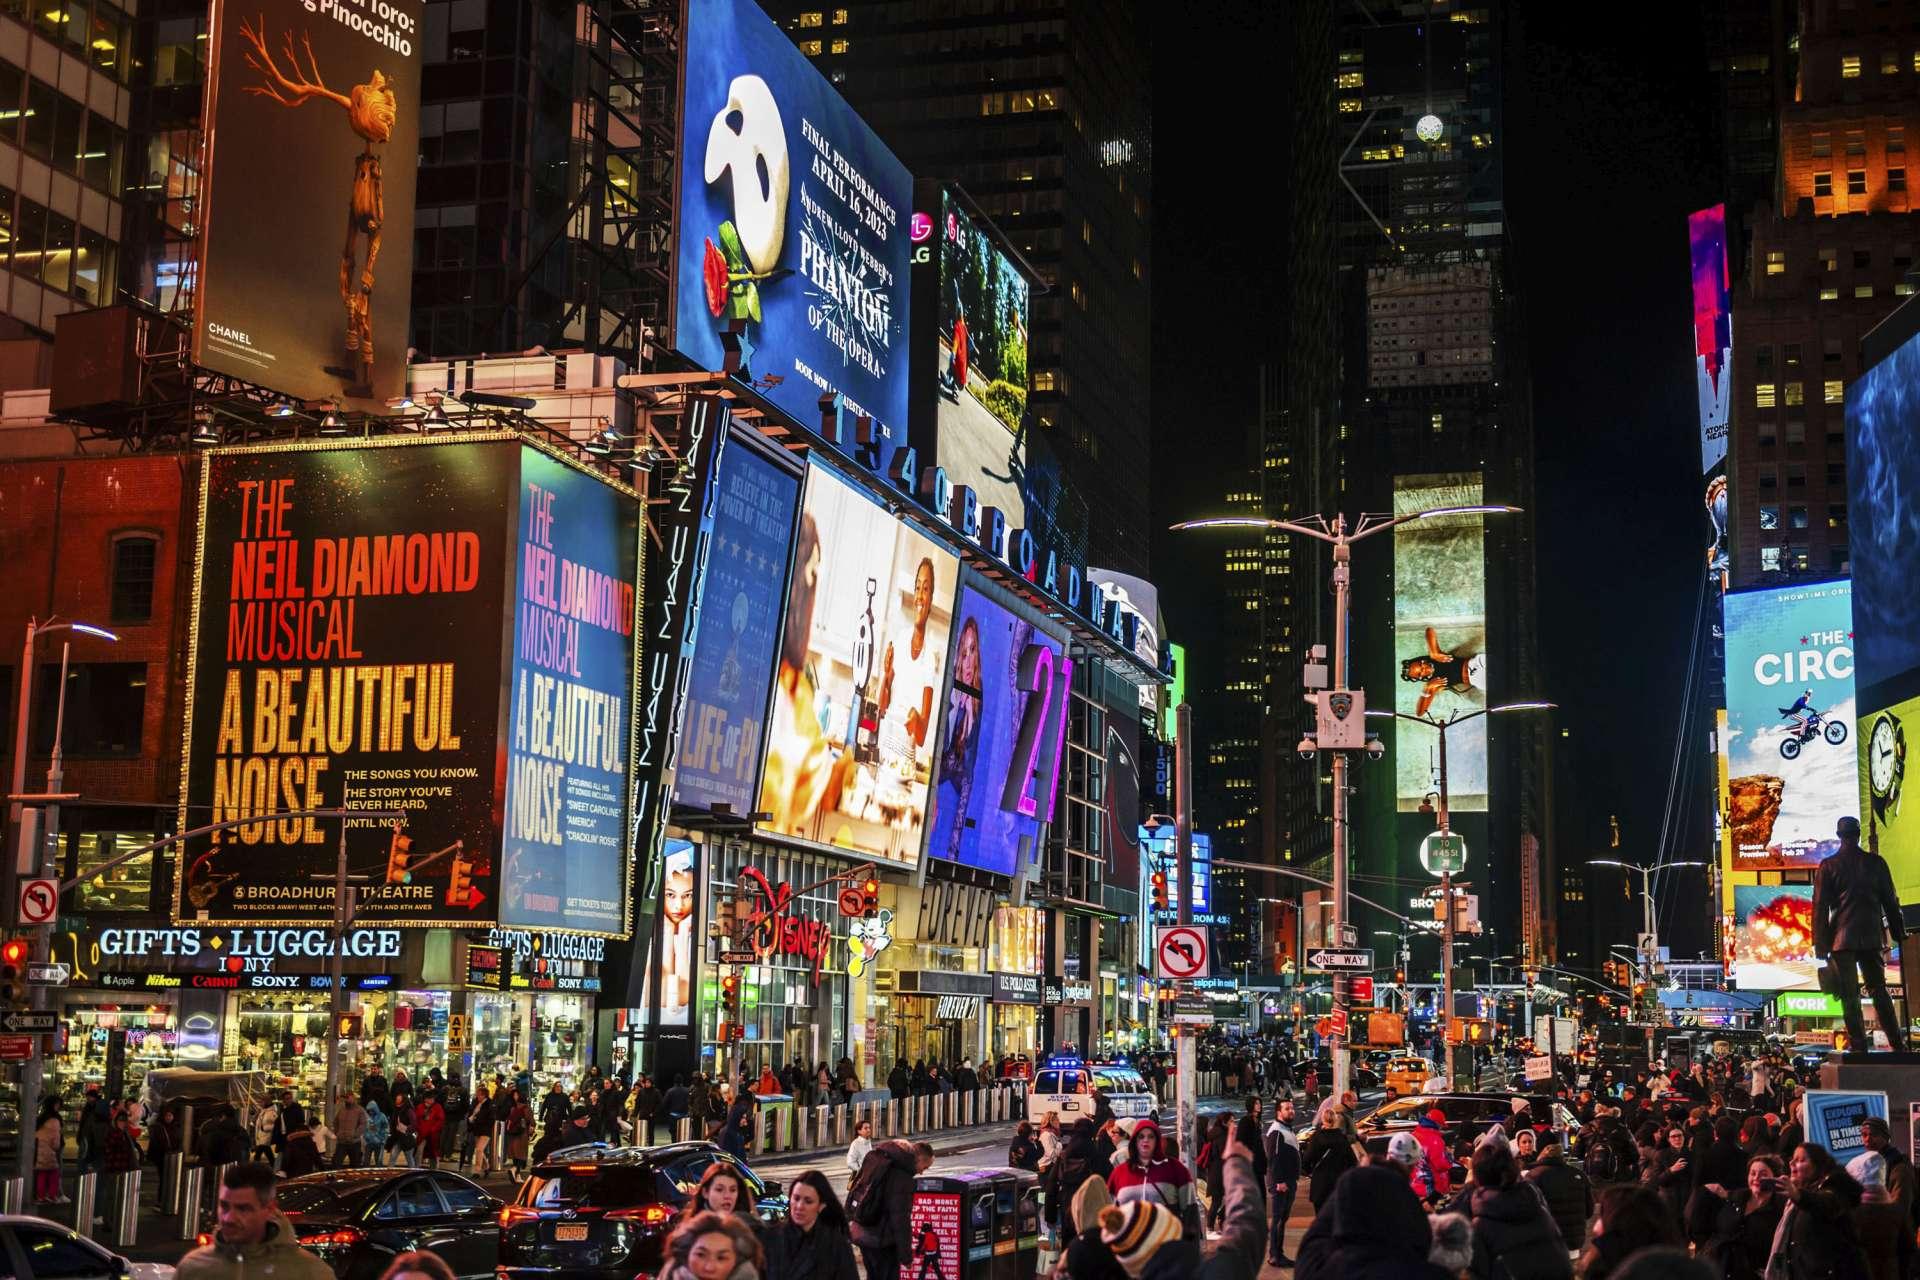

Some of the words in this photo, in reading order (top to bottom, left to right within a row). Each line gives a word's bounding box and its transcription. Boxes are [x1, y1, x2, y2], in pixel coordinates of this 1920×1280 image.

[320, 0, 412, 57] Pinocchio
[802, 118, 831, 161] FINAL
[833, 149, 896, 227] PERFORMANCE
[812, 154, 846, 202] APRIL
[849, 189, 863, 223] 16,
[866, 206, 887, 241] 2023
[801, 181, 832, 229] ANDREW
[834, 221, 859, 256] LLOYD
[860, 246, 893, 287] WEBBER'S
[957, 224, 966, 250] LG
[800, 230, 892, 348] PHANTOM
[208, 322, 251, 345] CHANEL
[808, 304, 822, 331] OF
[826, 318, 846, 351] THE
[848, 338, 881, 380] OPERA
[795, 358, 813, 381] BOOK
[813, 372, 828, 393] NOW
[730, 474, 760, 506] BELIEVE
[238, 479, 295, 539] THE
[528, 483, 555, 551] THE
[818, 393, 947, 514] 1540
[953, 485, 1139, 651] BROADWAY
[230, 541, 305, 600] NEIL
[313, 531, 480, 598] DIAMOND
[523, 543, 556, 611] NEIL
[560, 558, 633, 636] DIAMOND
[1778, 591, 1825, 602] SHOWTIME
[226, 598, 362, 661] MUSICAL
[520, 602, 581, 678] MUSICAL
[1811, 630, 1844, 645] THE
[1754, 646, 1855, 685] CIRC
[216, 668, 244, 754] A
[253, 662, 460, 754] BEAUTIFUL
[514, 669, 528, 741] A
[532, 678, 623, 774] BEAUTIFUL
[682, 699, 728, 775] LIFE
[736, 717, 760, 783] PI
[1002, 645, 1074, 823] 21
[344, 770, 368, 780] THE
[370, 769, 411, 780] SONGS
[413, 768, 438, 779] YOU
[440, 767, 478, 778] KNOW.
[1155, 744, 1166, 796] 1500
[211, 757, 329, 845] NOISE
[344, 788, 367, 798] THE
[369, 787, 407, 798] STORY
[409, 786, 452, 798] YOU'VE
[344, 800, 383, 811] NEVER
[385, 799, 428, 811] HEARD,
[511, 758, 563, 846] NOISE
[344, 818, 377, 828] UNTIL
[379, 817, 410, 828] NOW.
[566, 815, 597, 828] "AMERICA"
[248, 886, 337, 899] BROADHUR
[361, 886, 434, 899] THEATRE
[917, 880, 995, 947] FOREVER
[100, 929, 200, 957] GIFTS
[230, 929, 400, 957] LUGGAGE
[489, 929, 531, 956] GIFTS
[542, 933, 605, 961] LUGGAGE
[218, 957, 227, 972] I
[243, 957, 274, 972] NY
[1316, 955, 1335, 964] ONE
[1344, 955, 1364, 964] WAY
[113, 976, 134, 987] Apple
[145, 974, 182, 987] Nikon
[192, 975, 240, 988] Canon
[310, 976, 347, 988] BOWR
[559, 979, 582, 988] SONY
[1010, 976, 1022, 991] POLO
[936, 996, 969, 1020] FOREVER
[969, 997, 979, 1020] 21
[1786, 998, 1828, 1011] YORK
[9, 1018, 25, 1026] ONE
[34, 1018, 50, 1026] WAY
[451, 1016, 461, 1047] ATM
[1825, 1104, 1864, 1119] EXPLORE
[1829, 1129, 1839, 1140] IN
[1841, 1126, 1862, 1138] TIME
[1832, 1136, 1864, 1150] SQUAR
